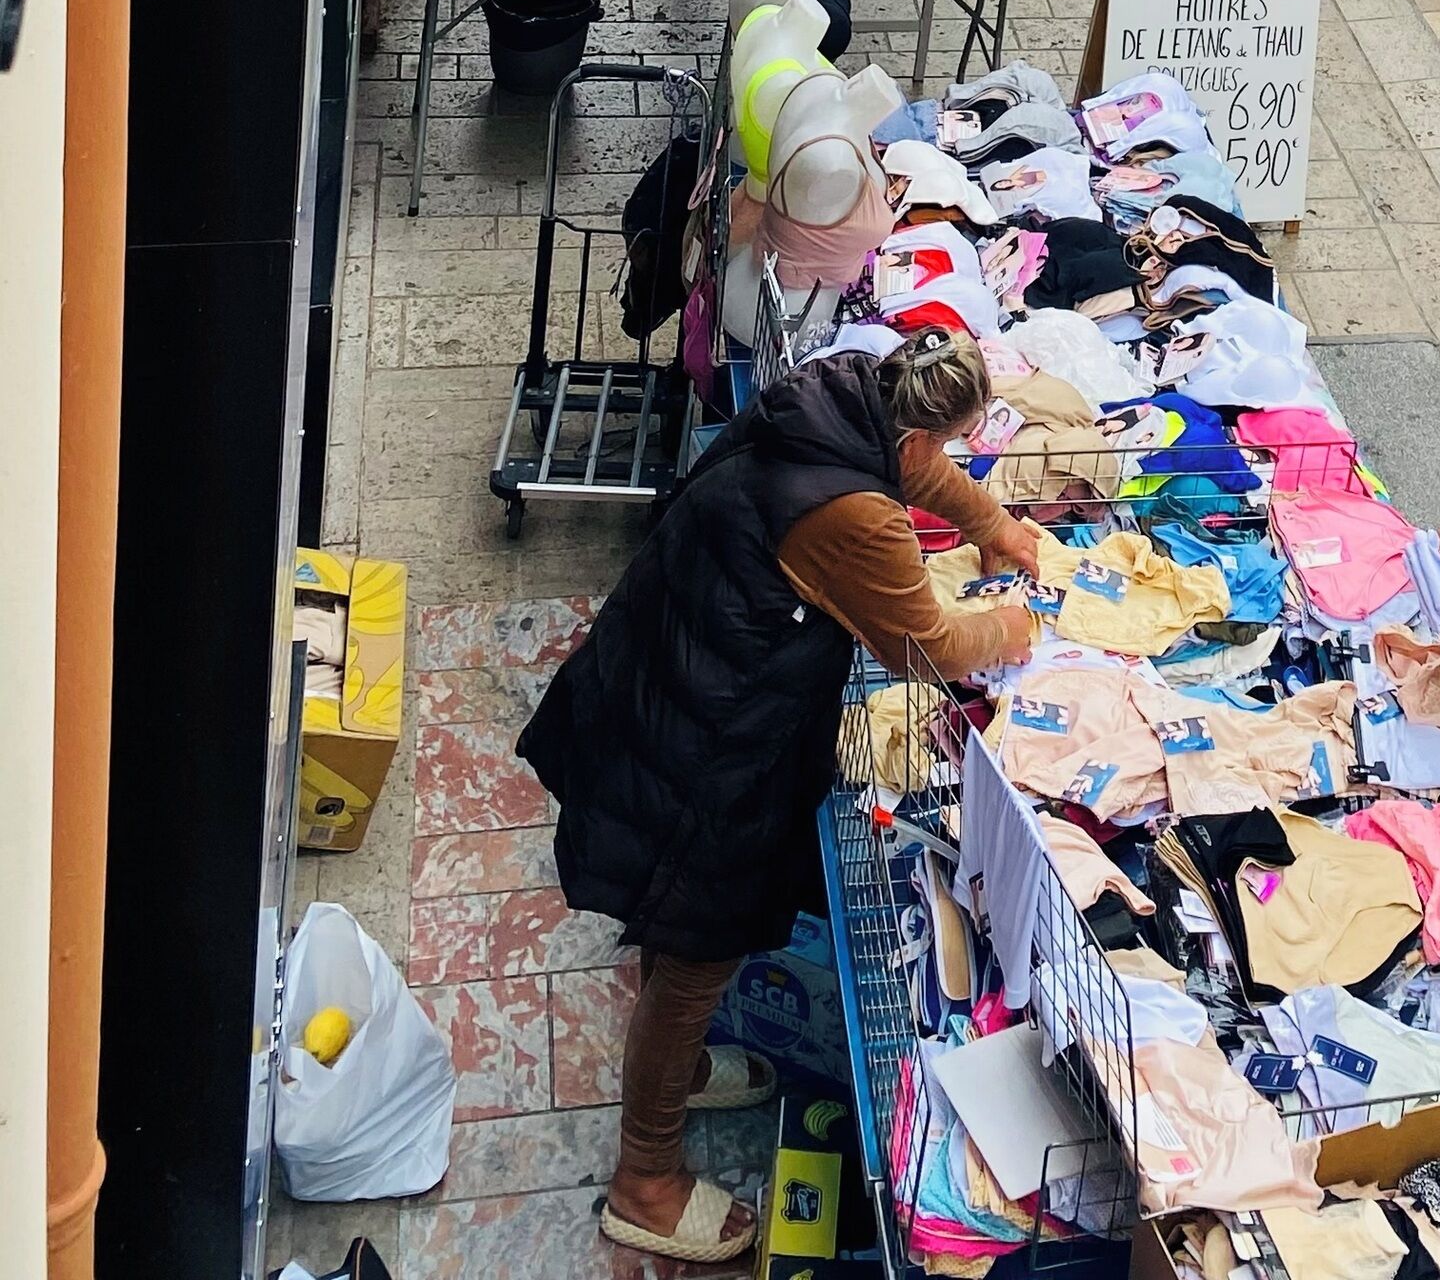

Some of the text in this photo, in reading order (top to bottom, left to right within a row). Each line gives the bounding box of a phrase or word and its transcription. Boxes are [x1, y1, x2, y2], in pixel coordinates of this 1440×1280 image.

[1121, 28, 1148, 60] DE
[1236, 44, 1248, 58] de
[1251, 26, 1303, 58] THAU
[750, 978, 799, 1014] SCB
